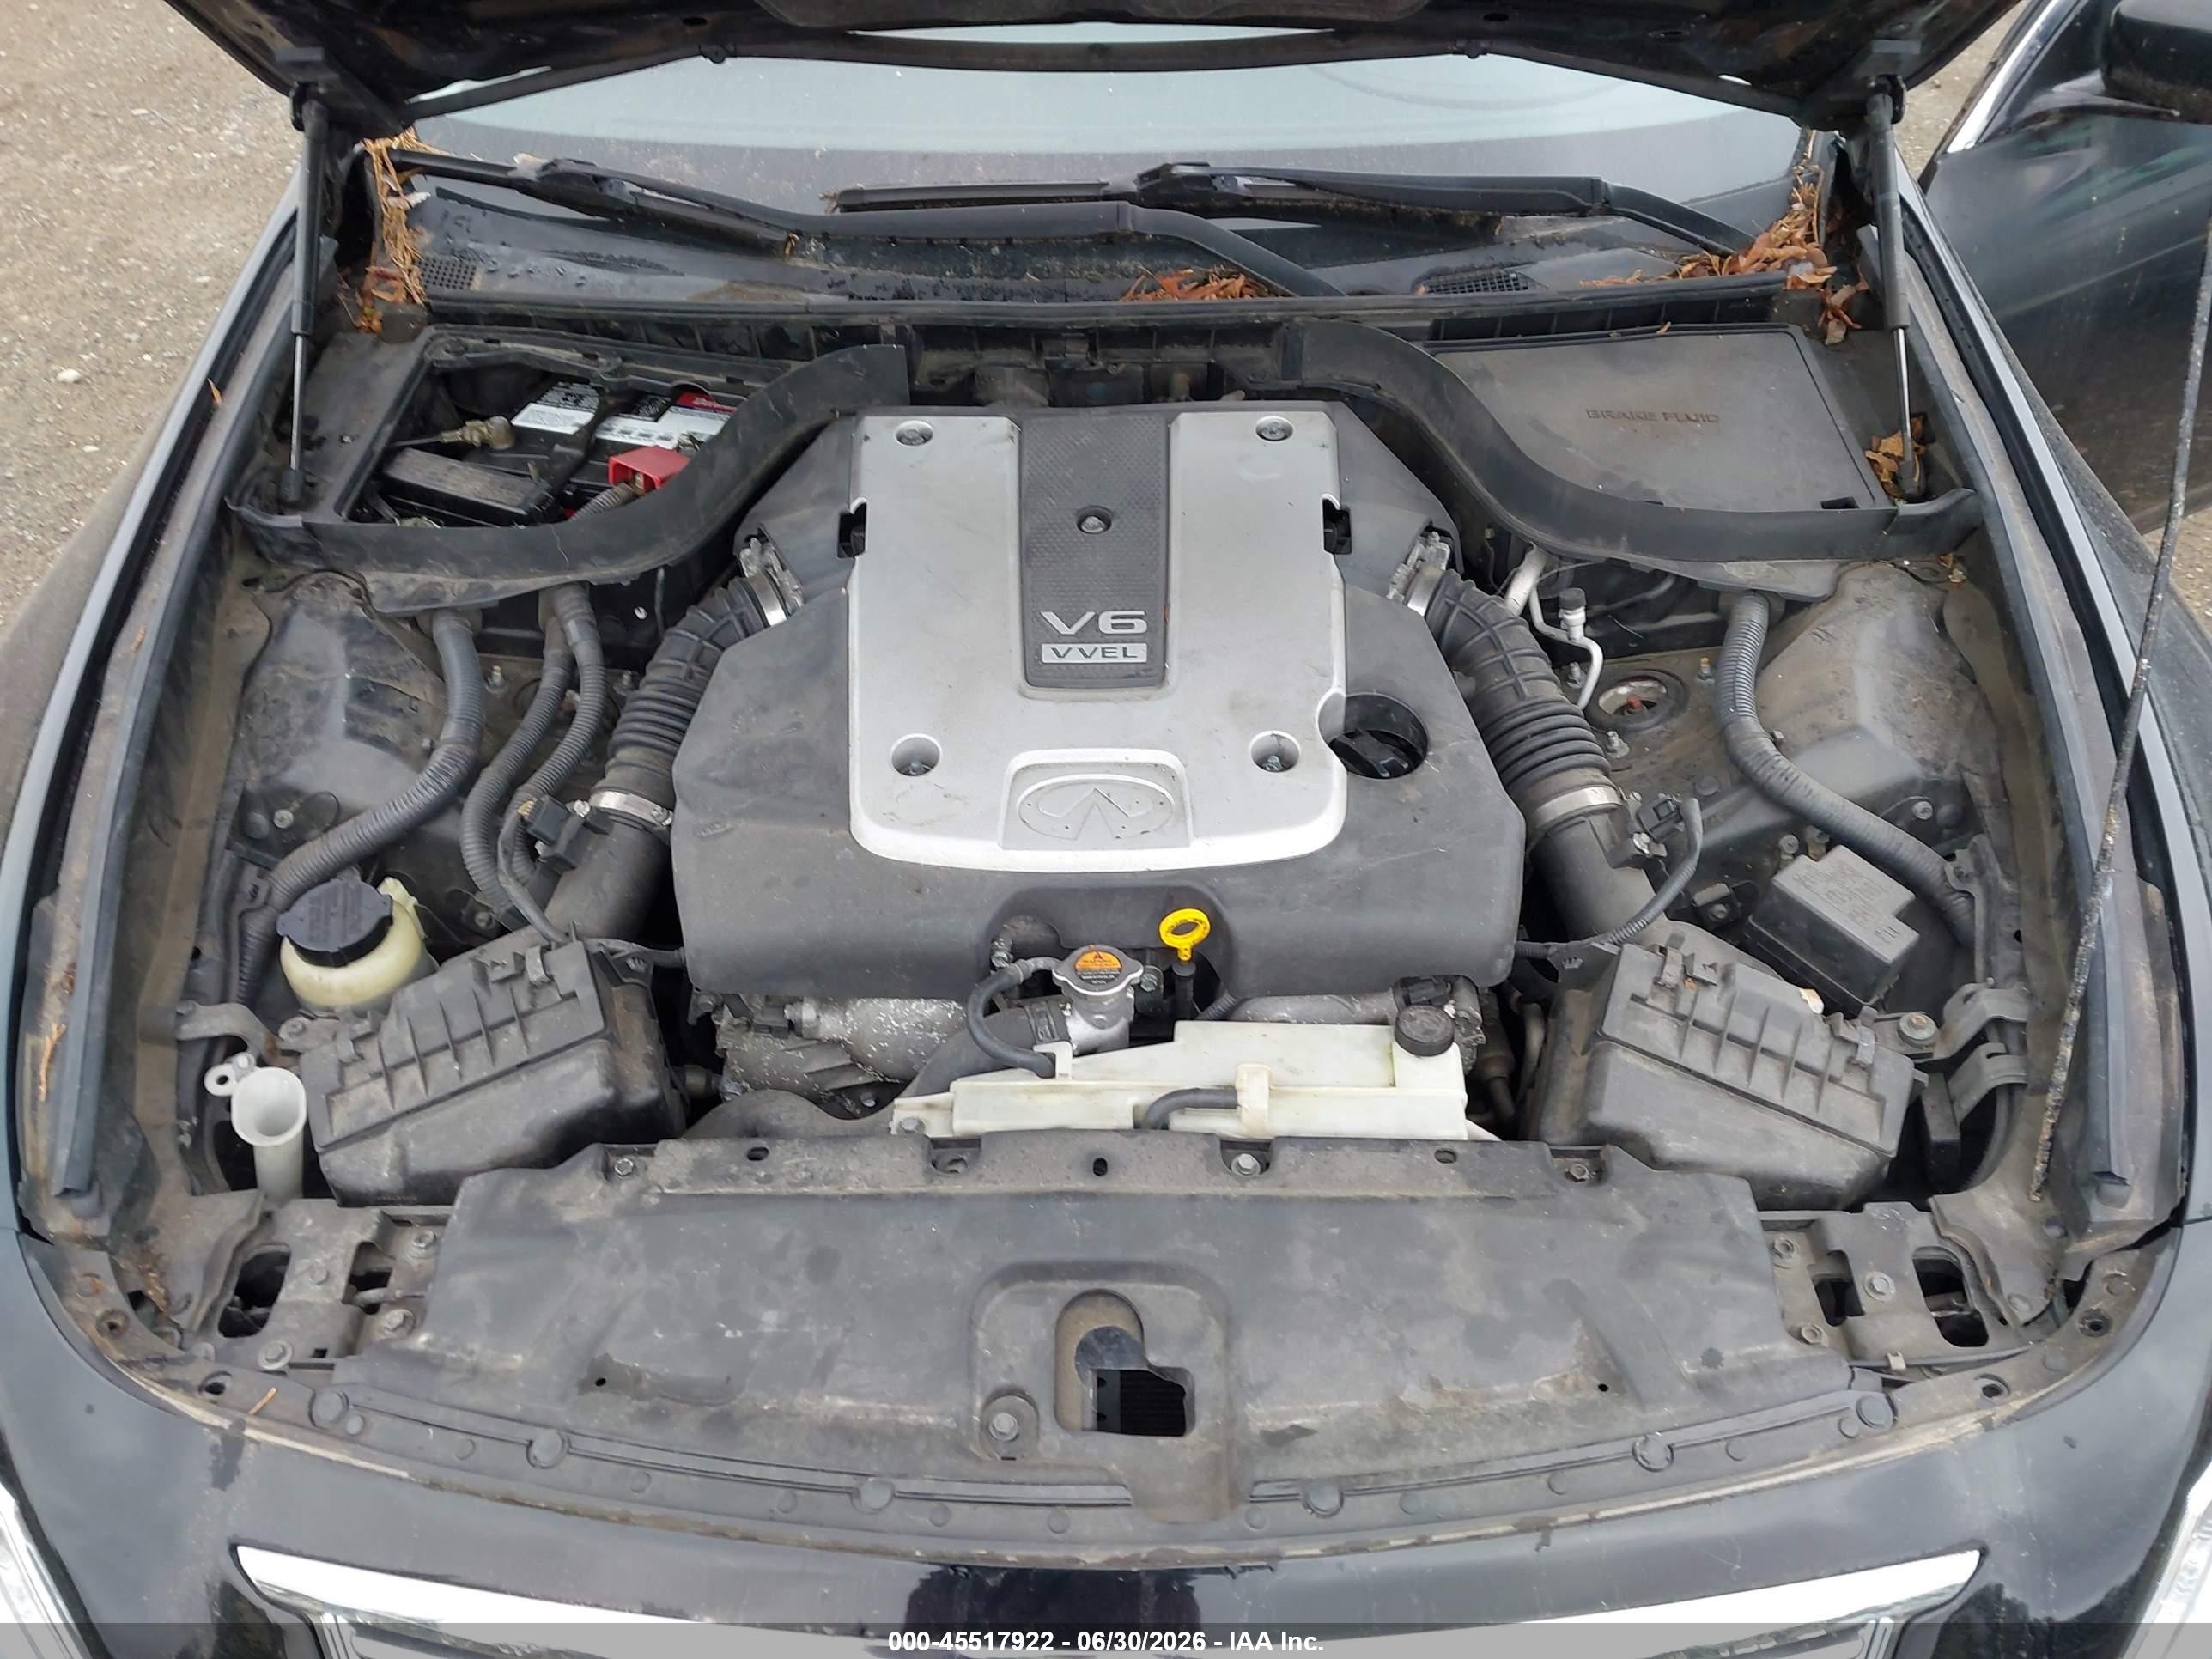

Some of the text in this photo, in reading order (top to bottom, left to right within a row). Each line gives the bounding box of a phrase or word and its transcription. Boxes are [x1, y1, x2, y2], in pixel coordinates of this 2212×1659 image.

[1586, 408, 1719, 423] BRAKE FLUID
[1040, 611, 1147, 635] V6
[1051, 647, 1138, 659] VVEL
